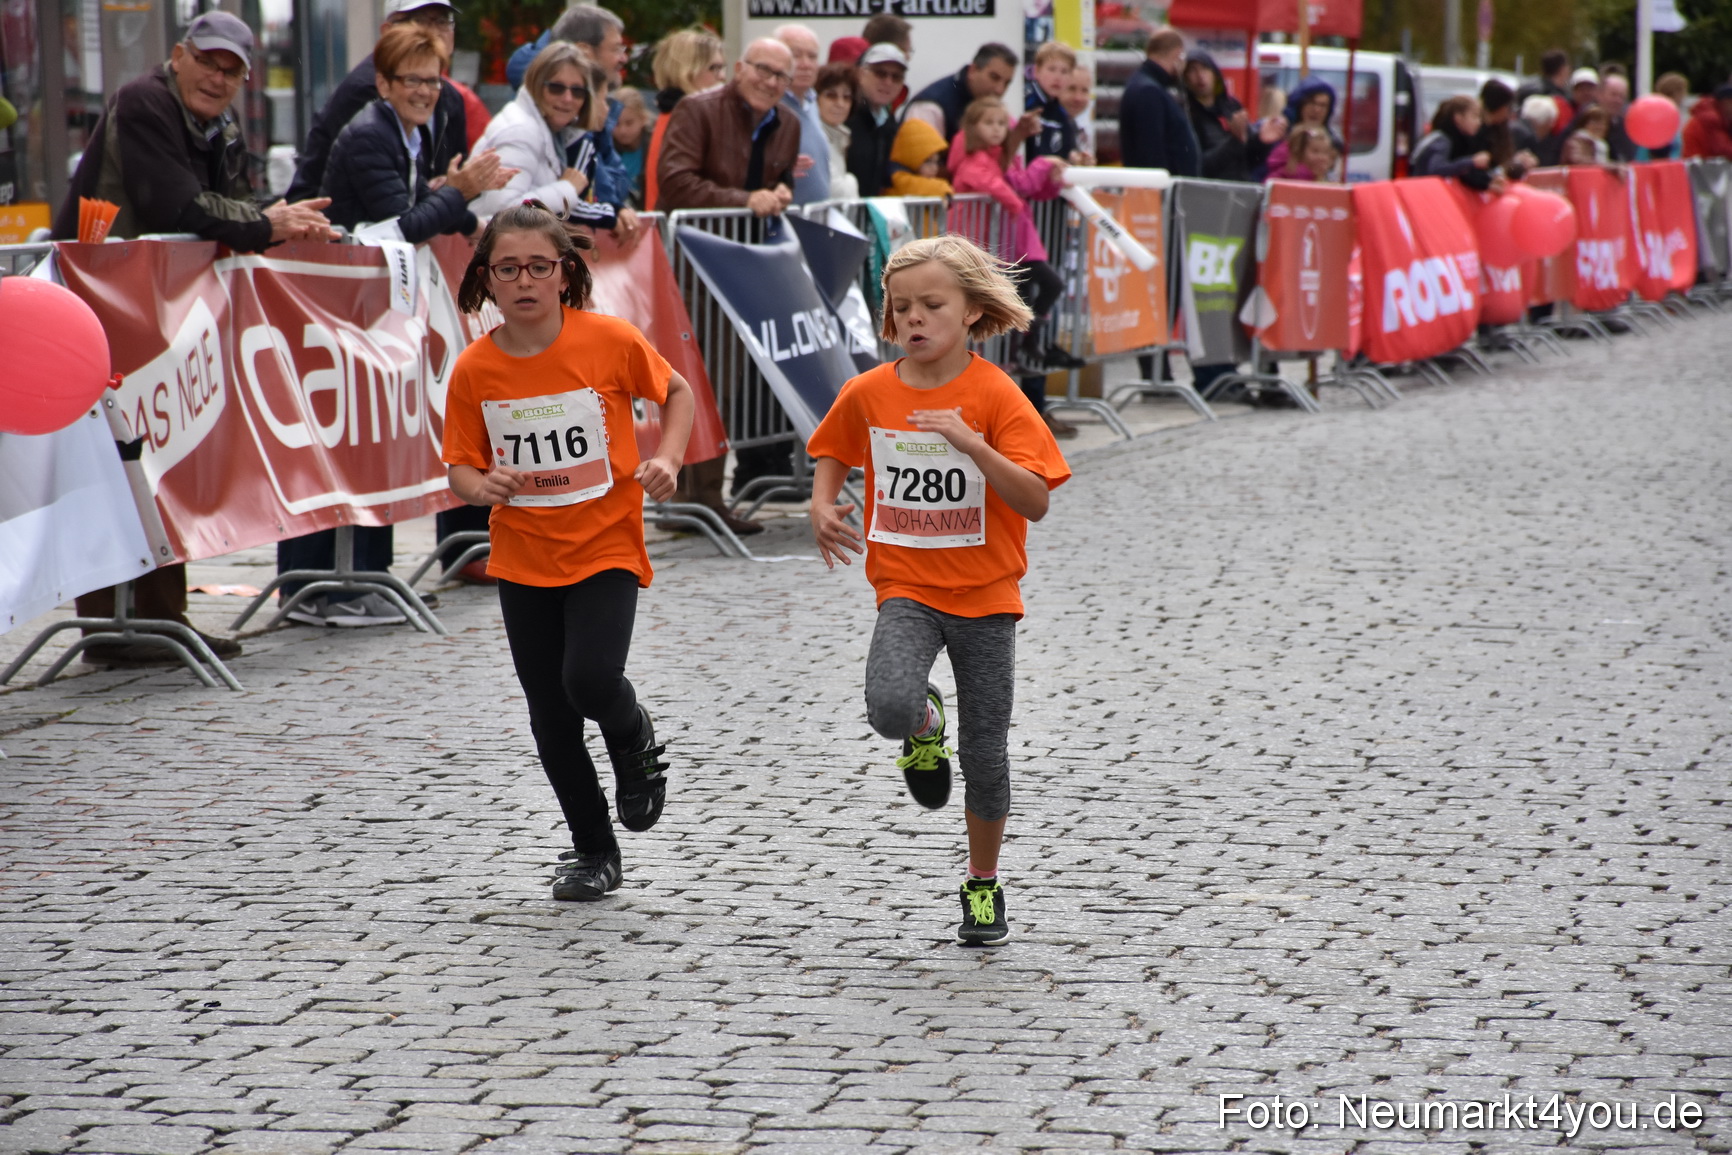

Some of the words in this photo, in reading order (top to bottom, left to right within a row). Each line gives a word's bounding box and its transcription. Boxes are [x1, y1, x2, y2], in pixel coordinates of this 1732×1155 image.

[176, 328, 218, 432] NEUE
[523, 404, 564, 418] BOCK
[503, 426, 588, 465] 7116
[907, 443, 948, 453] BOCK
[534, 474, 570, 488] Emilia
[886, 466, 966, 503] 7280
[885, 506, 981, 532] JOHANNA
